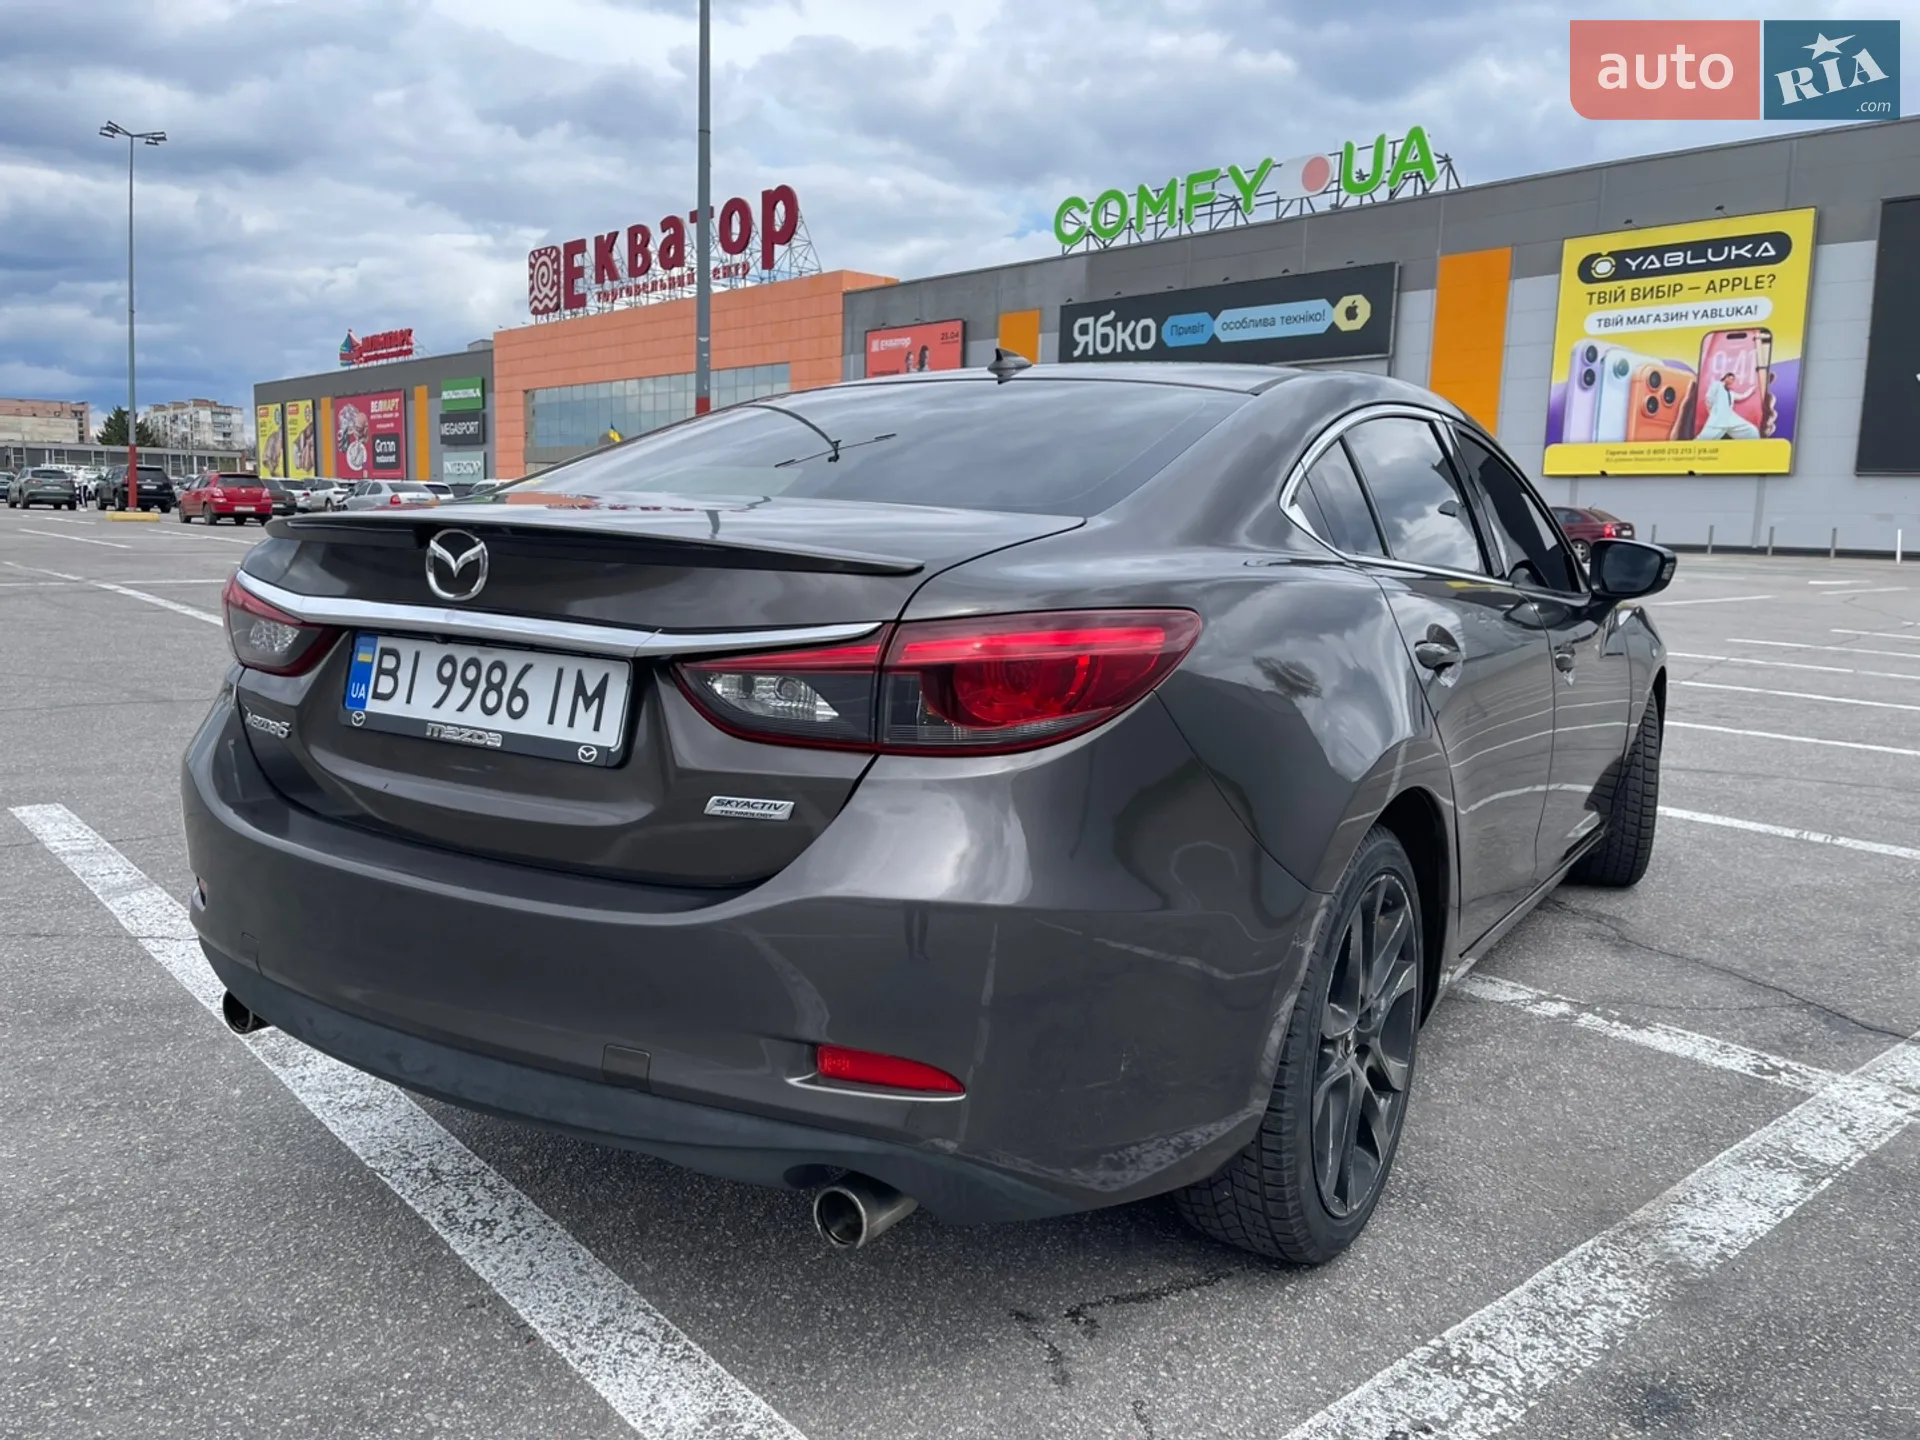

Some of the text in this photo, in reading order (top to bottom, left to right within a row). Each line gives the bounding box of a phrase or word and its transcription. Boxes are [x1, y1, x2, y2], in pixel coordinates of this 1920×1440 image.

[1054, 126, 1439, 246] COMFY UA
[1624, 241, 1777, 271] YABLUKA
[711, 260, 750, 280] ентр
[1586, 286, 1626, 306] ТВІЙ
[1630, 283, 1684, 301] ВИБІР
[1705, 274, 1777, 294] APPLE?
[1170, 309, 1326, 337] Привіт особлива техніко!
[1596, 305, 1758, 328] ТВІЙ МАГАЗИН YABLUKA!
[1073, 310, 1156, 357] Ябко
[441, 421, 479, 435] MEGASPORT
[350, 682, 366, 700] UA
[371, 647, 610, 732] BI 9986 IM
[714, 798, 785, 811] SKYACTIV
[720, 809, 774, 818] TECHNOLOGY
